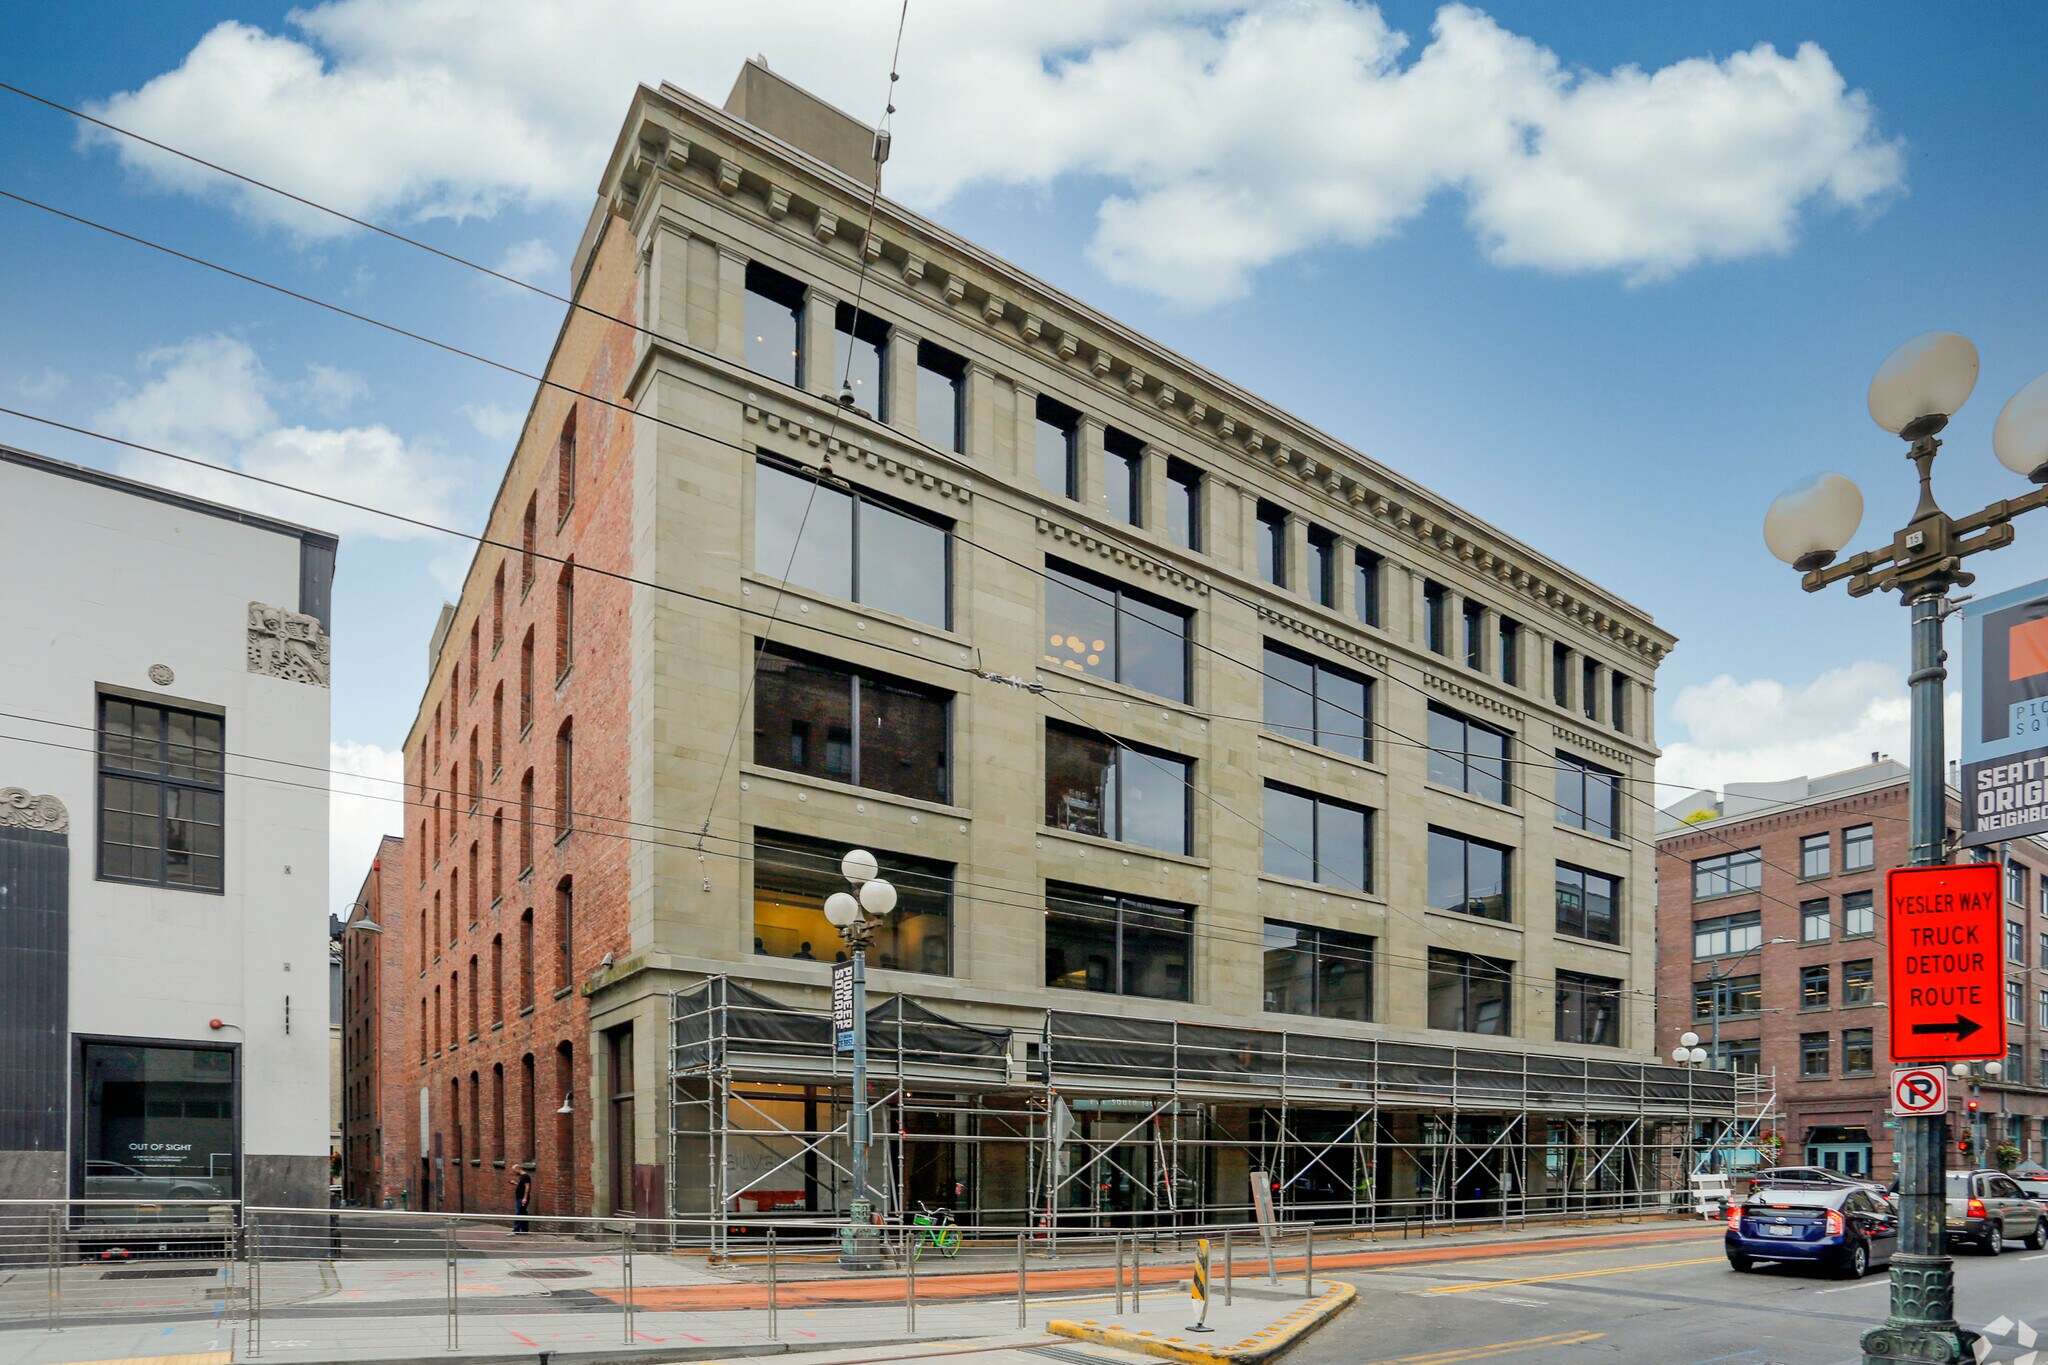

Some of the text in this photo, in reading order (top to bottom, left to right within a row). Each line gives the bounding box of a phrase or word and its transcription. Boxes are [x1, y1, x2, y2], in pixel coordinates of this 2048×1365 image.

[2016, 719, 2048, 736] SQ
[1895, 891, 1993, 915] YESLER WAY
[1910, 925, 1979, 946] TRUCK
[1906, 953, 1984, 974] DETOUR
[834, 969, 844, 1029] SQUARE
[843, 966, 853, 1029] PIONEER
[1910, 985, 1982, 1007] ROUTE
[129, 1143, 192, 1151] OUT OF SIGHT
